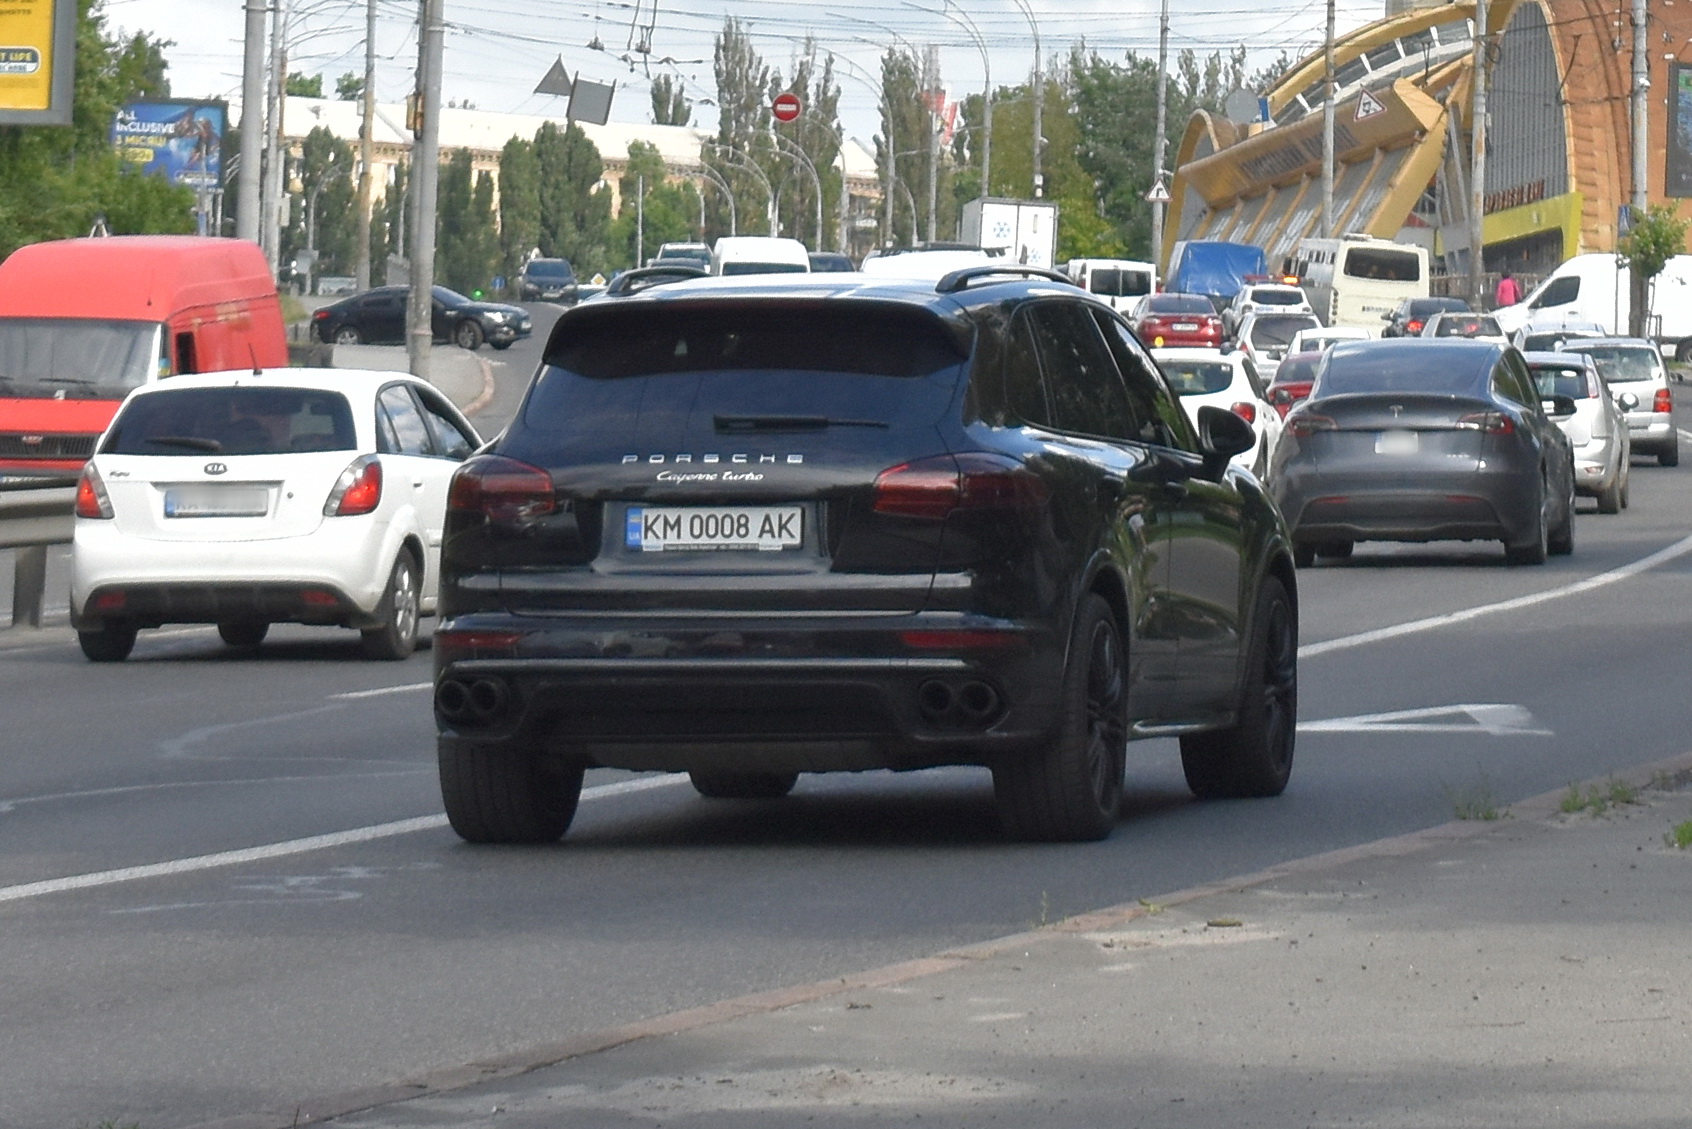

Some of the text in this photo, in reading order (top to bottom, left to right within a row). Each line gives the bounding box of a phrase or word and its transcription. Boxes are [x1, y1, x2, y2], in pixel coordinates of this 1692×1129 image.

[9, 52, 33, 61] LIFE
[115, 121, 176, 133] INCLUSIVE
[621, 453, 804, 464] PORSCHE
[205, 463, 227, 474] KIA
[656, 470, 764, 484] Cayenne turbo
[643, 513, 796, 539] KM 0008 AK
